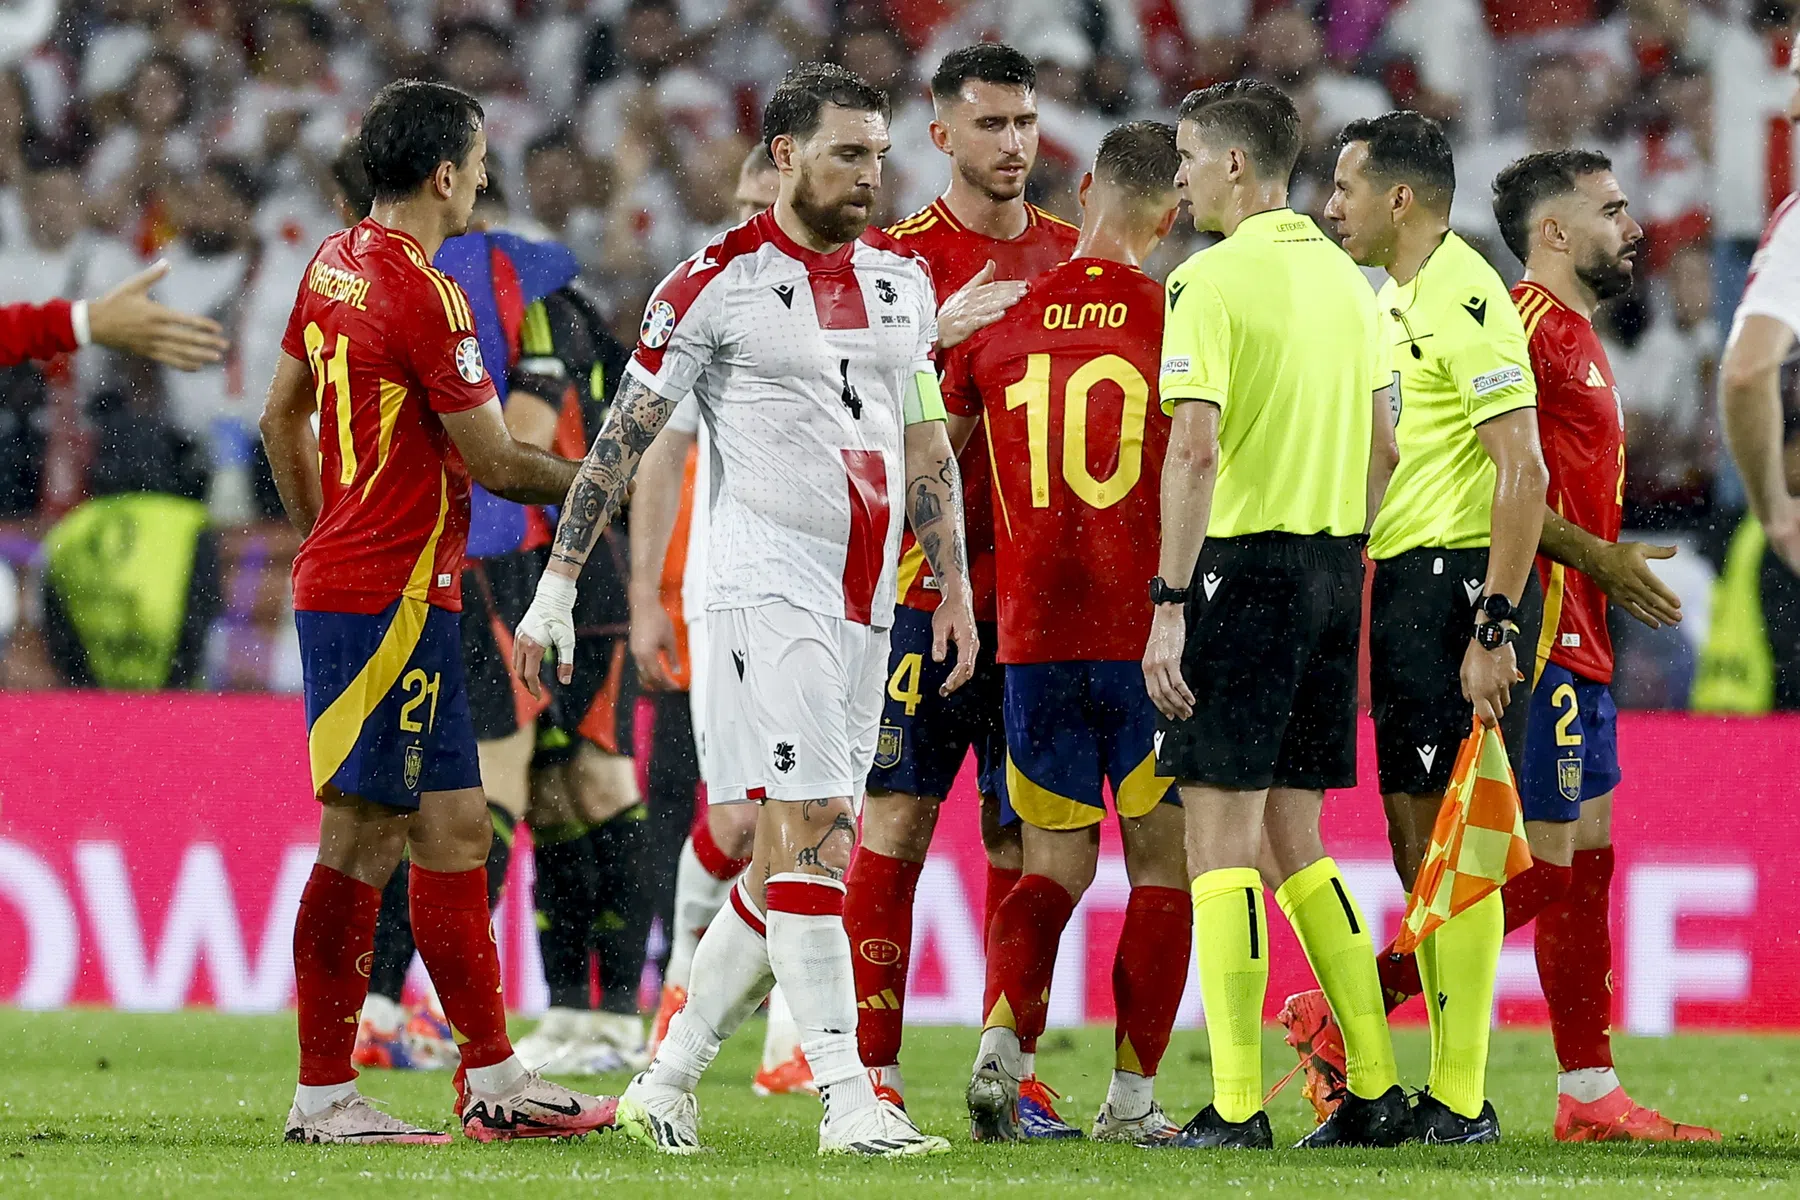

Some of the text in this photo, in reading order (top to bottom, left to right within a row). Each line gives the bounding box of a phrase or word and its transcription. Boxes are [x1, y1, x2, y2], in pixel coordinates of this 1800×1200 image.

[1043, 302, 1128, 330] OLMO
[840, 358, 863, 421] 4
[1474, 370, 1521, 391] FOUNDATON
[1005, 353, 1149, 510] 10
[400, 668, 440, 735] 21
[887, 652, 922, 716] 4
[1551, 683, 1582, 746] 2
